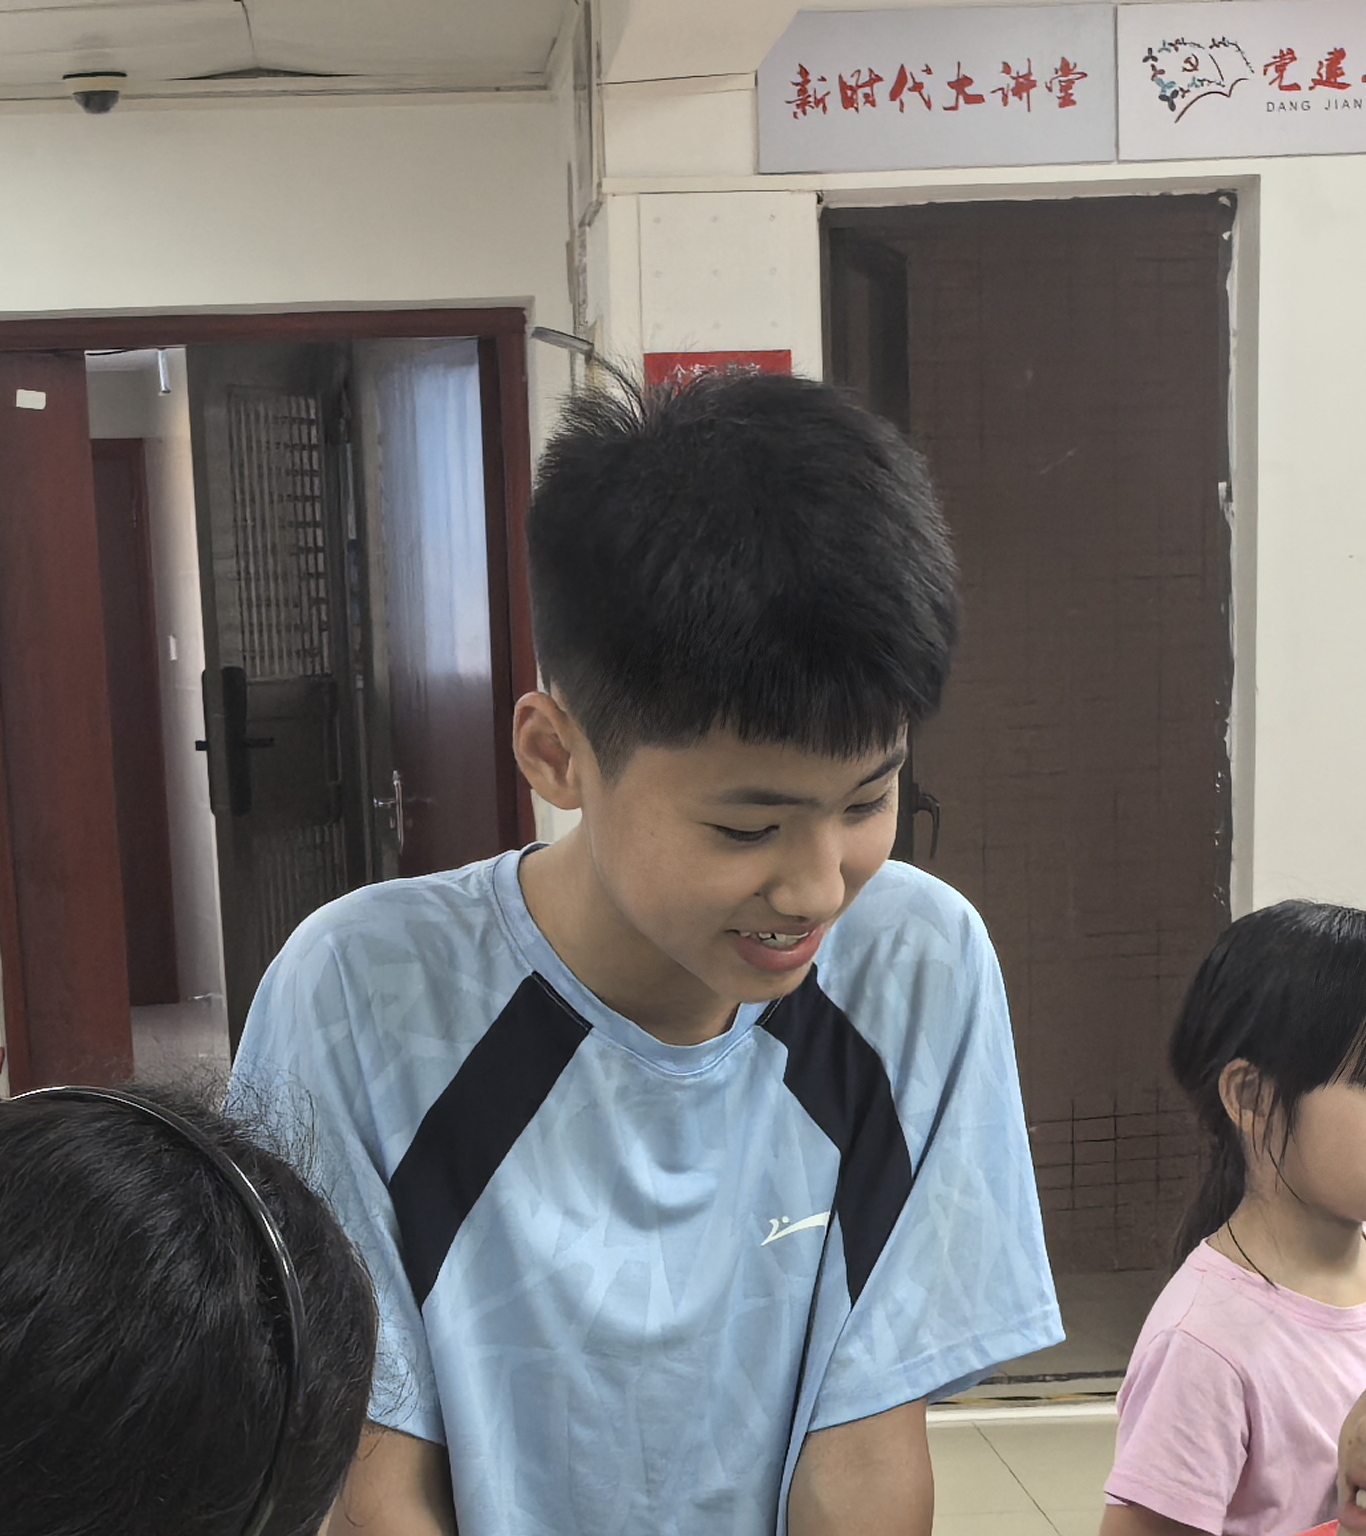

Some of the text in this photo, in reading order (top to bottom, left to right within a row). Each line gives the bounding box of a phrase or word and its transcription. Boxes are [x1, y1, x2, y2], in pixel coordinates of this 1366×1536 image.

[785, 56, 1088, 120] 新时代大讲堂
[1266, 101, 1312, 113] DANG
[1324, 98, 1364, 110] JIAN
